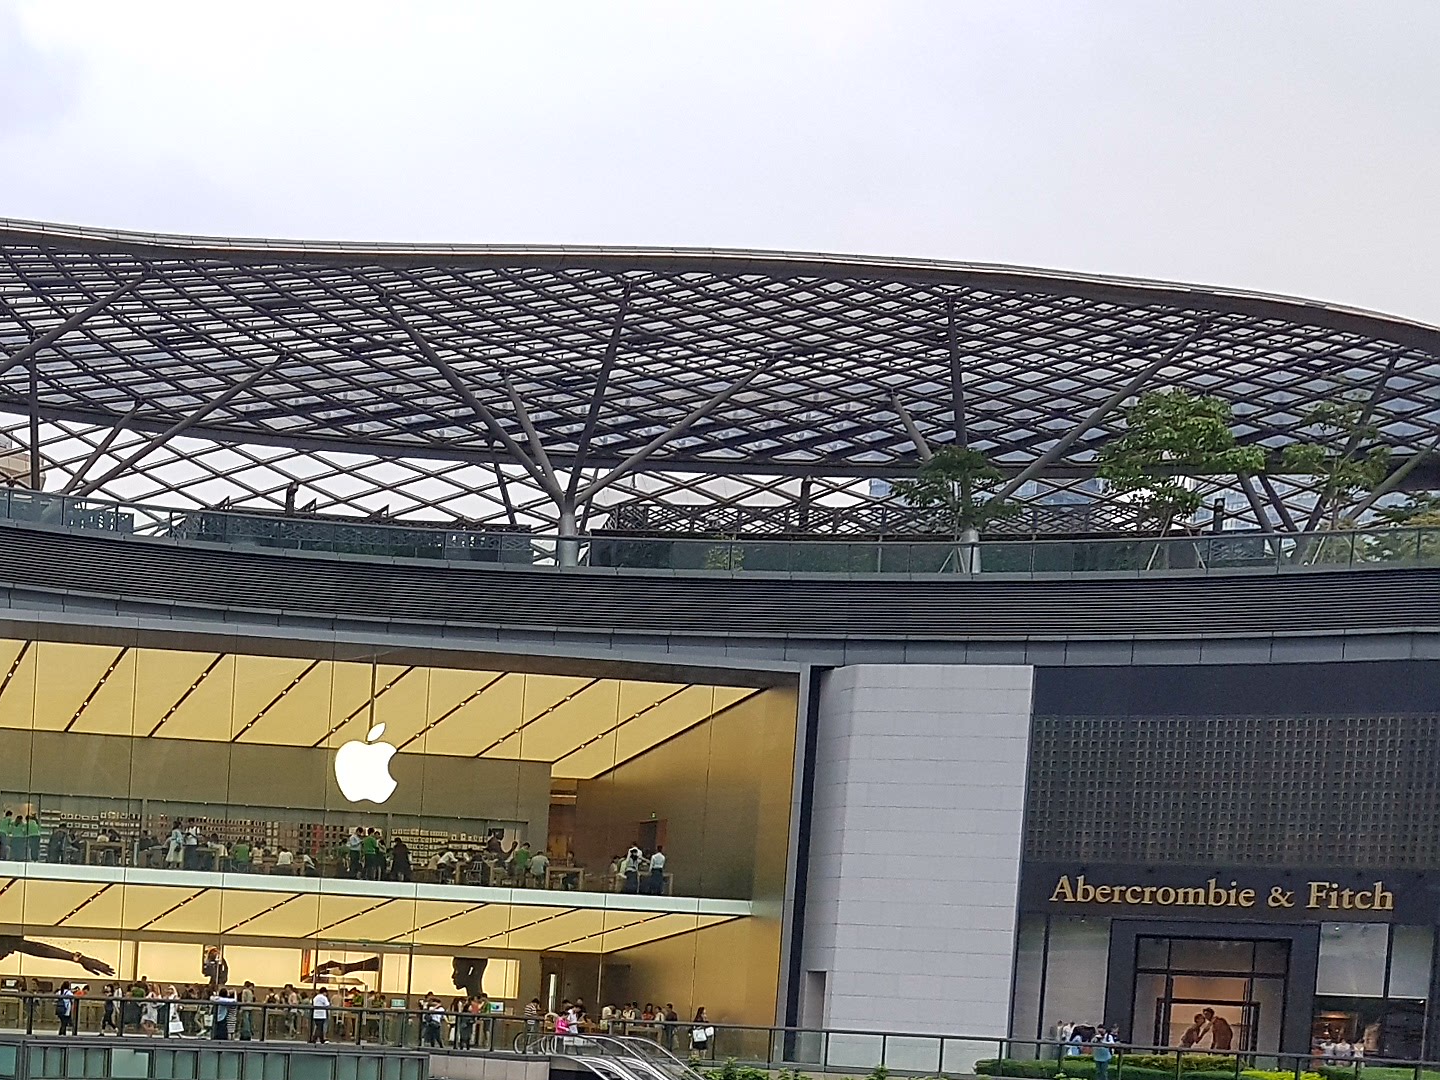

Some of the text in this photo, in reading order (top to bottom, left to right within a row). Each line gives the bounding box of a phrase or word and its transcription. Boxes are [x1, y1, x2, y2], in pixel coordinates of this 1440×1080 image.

[1048, 874, 1395, 911] Abercrombie & Fitch
